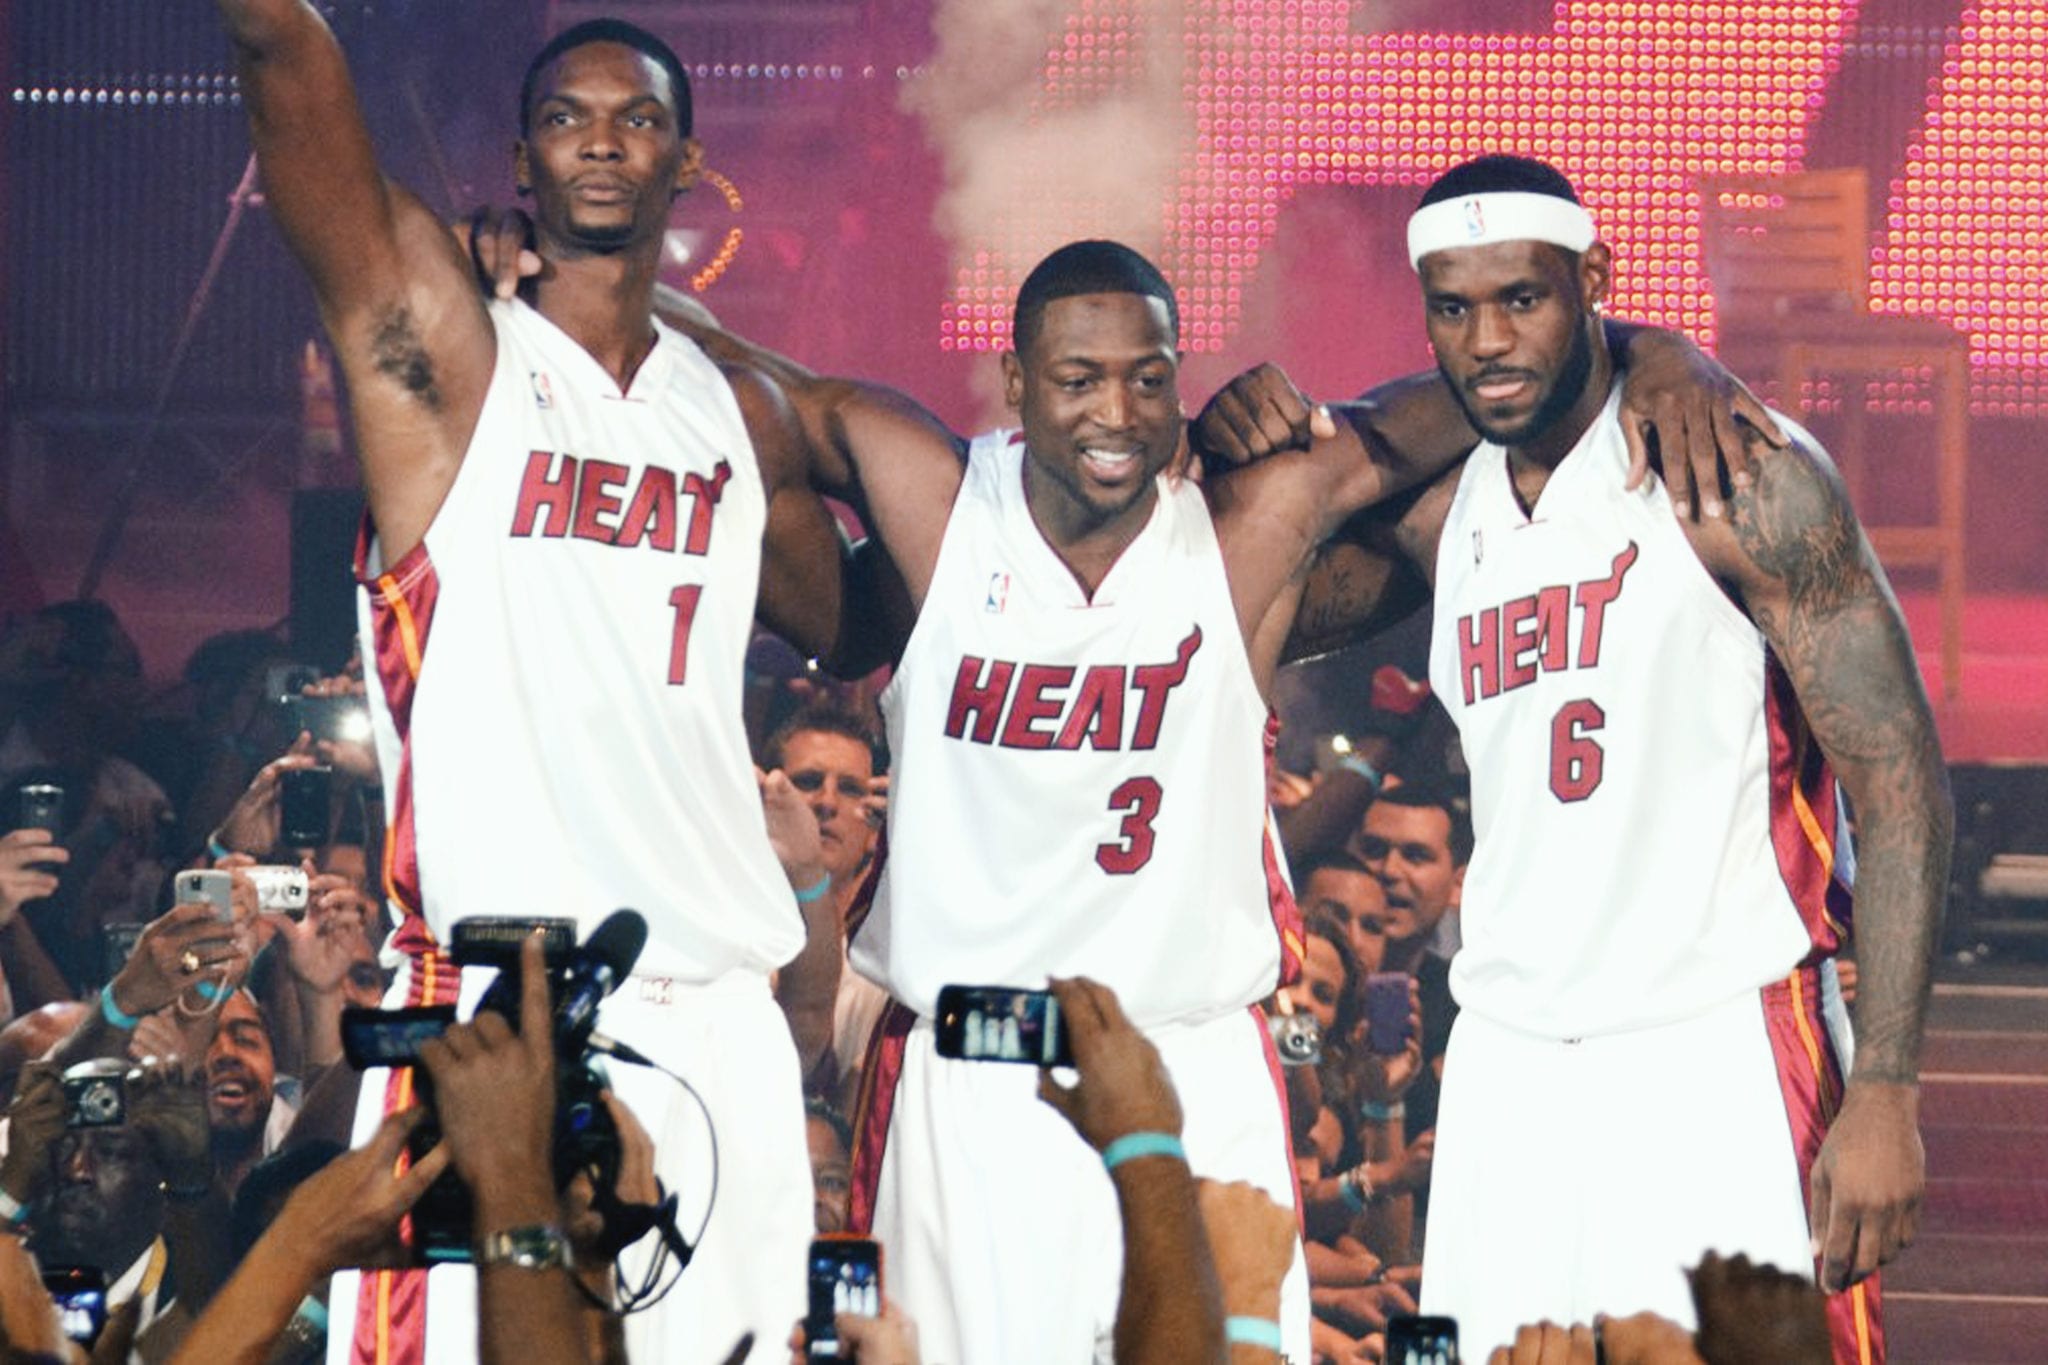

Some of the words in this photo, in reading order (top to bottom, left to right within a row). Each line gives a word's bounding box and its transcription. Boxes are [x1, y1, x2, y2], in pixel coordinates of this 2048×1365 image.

[510, 451, 732, 556] HEAT
[668, 584, 702, 685] 1
[1458, 539, 1639, 706] HEAT
[944, 625, 1202, 751] HEAT
[1550, 699, 1605, 803] 6
[1095, 776, 1163, 875] 3
